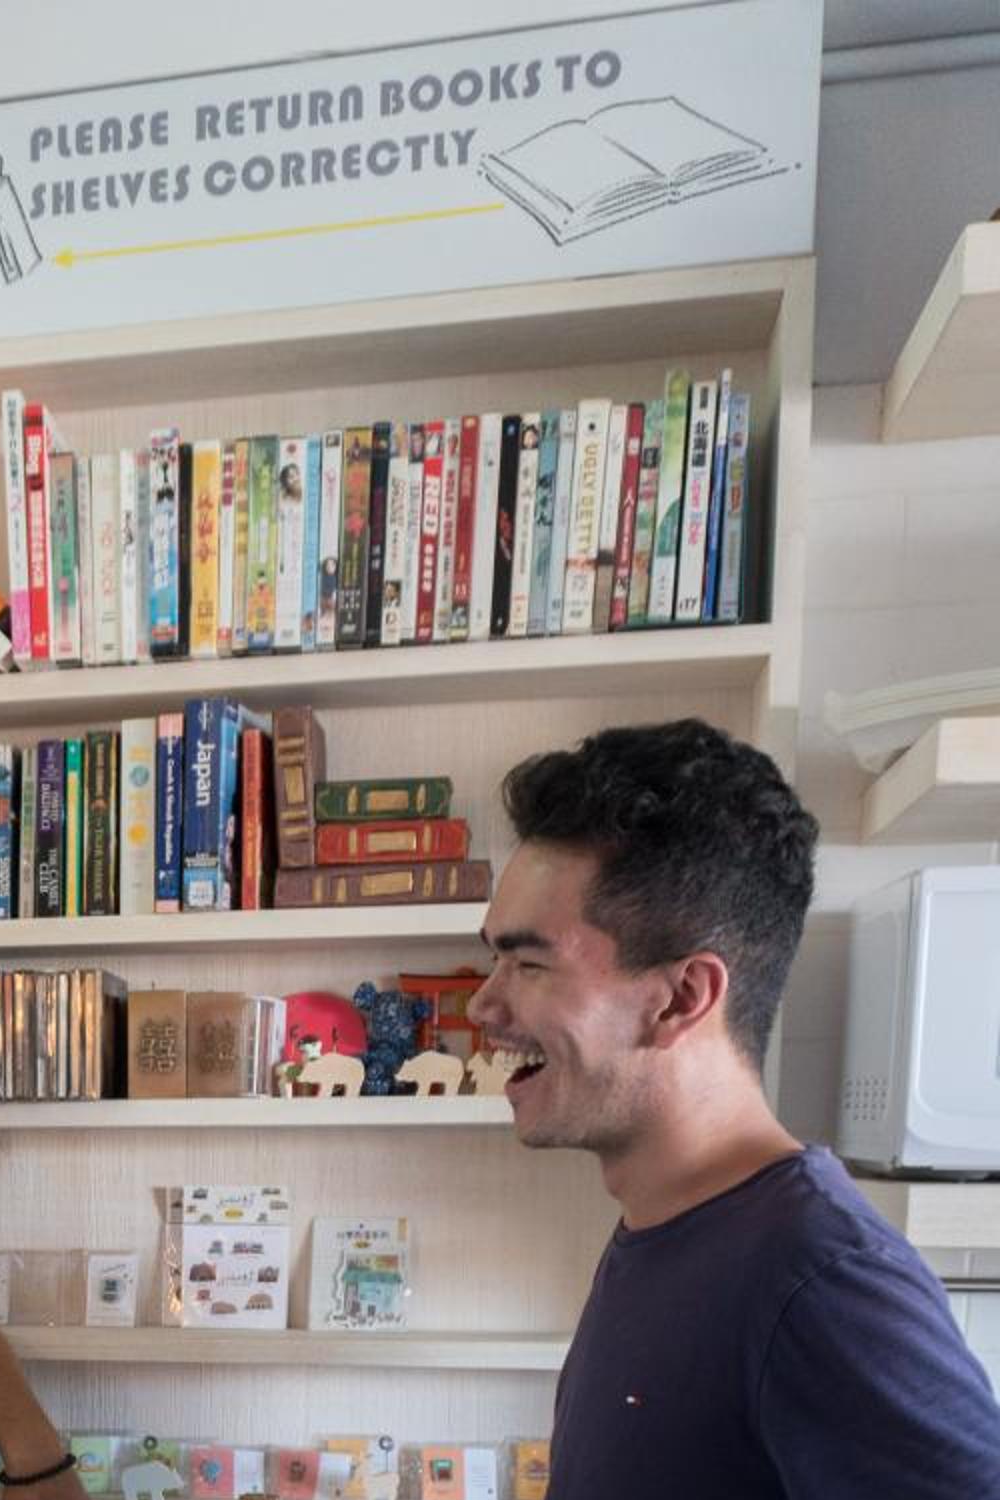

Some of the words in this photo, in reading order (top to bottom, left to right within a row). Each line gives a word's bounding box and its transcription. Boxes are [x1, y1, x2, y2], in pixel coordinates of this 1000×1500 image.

[29, 111, 170, 163] PLEASE
[195, 85, 364, 142] RETURN
[379, 59, 543, 117] BOOKS
[555, 50, 622, 92] TO
[30, 165, 191, 220] SHELVES
[203, 128, 477, 197] CORRECTLY
[192, 737, 215, 808] Japan
